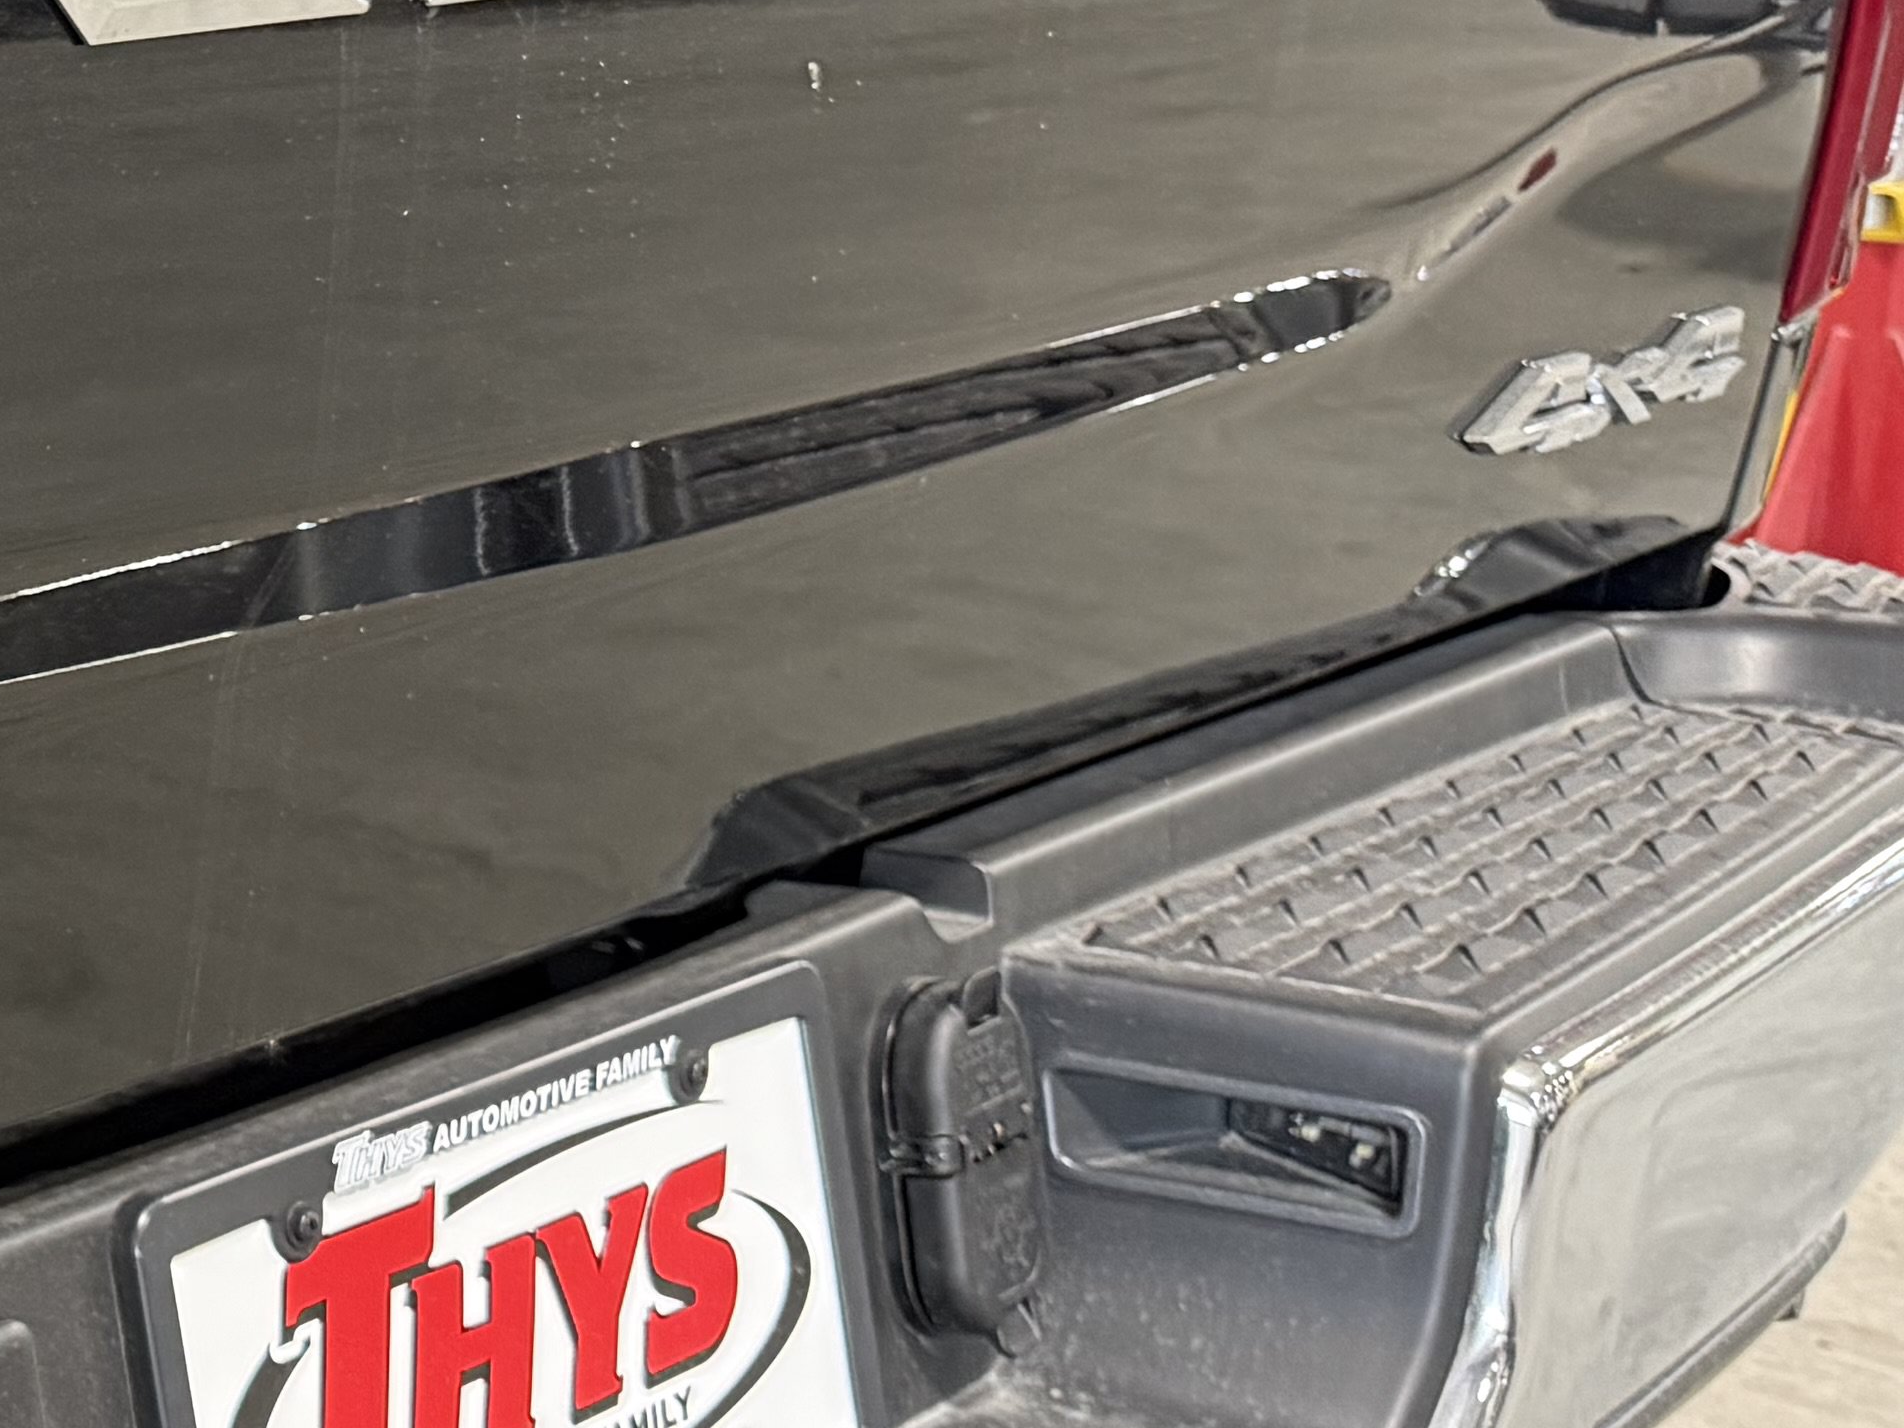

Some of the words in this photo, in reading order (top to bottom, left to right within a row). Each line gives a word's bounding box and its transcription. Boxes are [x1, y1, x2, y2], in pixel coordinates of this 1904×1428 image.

[332, 1120, 434, 1194] THYS
[432, 1068, 592, 1153] AUTOMOTIVE
[594, 1034, 680, 1092] FAMILY
